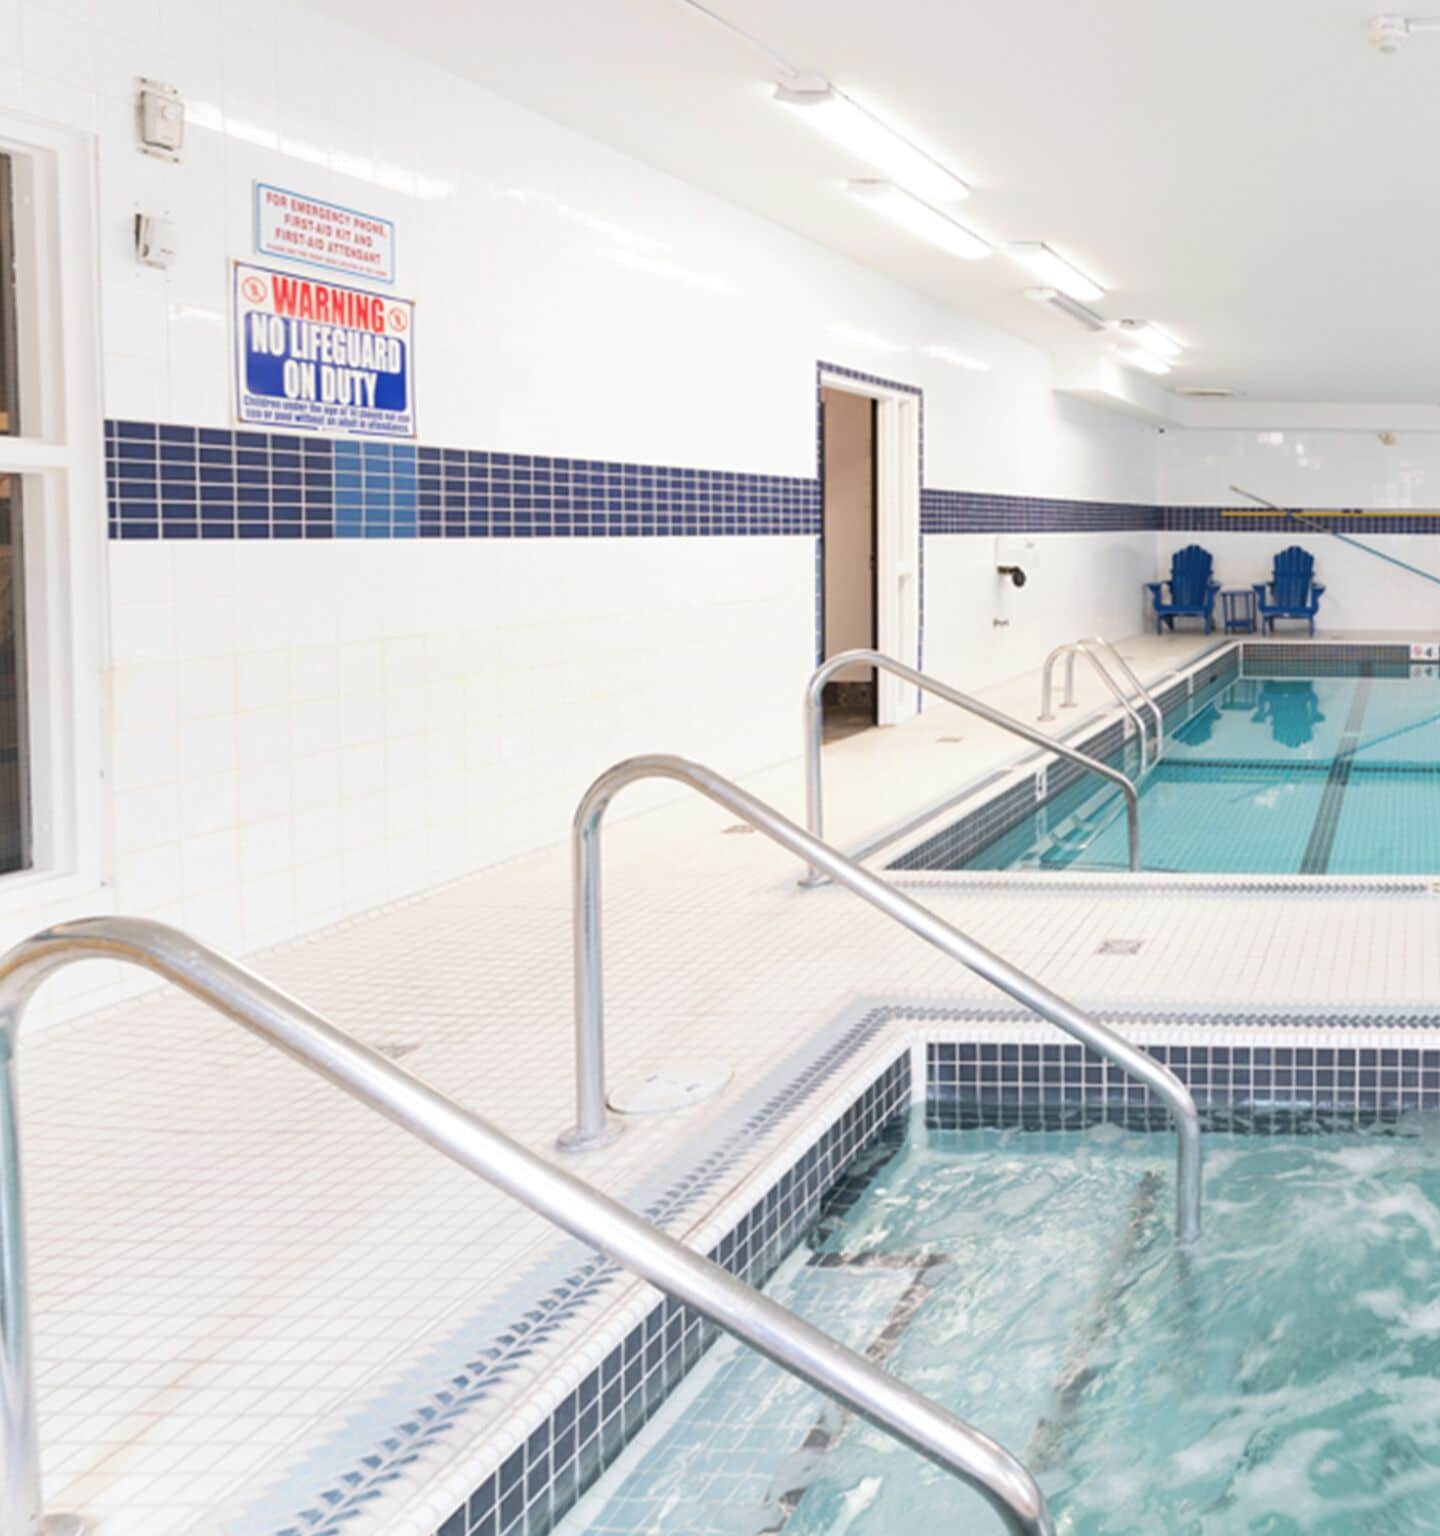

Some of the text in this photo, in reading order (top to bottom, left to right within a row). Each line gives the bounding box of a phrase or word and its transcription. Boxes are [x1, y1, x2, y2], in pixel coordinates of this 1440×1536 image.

[266, 191, 287, 206] FOR
[291, 199, 350, 225] EMERGENCY
[275, 227, 324, 250] FIRST-AID
[328, 242, 380, 264] ATTENDANT
[336, 228, 351, 240] KIT
[354, 234, 372, 248] AND
[272, 275, 384, 333] WARNING
[251, 313, 401, 375] NO LIFEGUARD
[283, 359, 377, 408] ON DUTY
[244, 395, 280, 409] Children
[283, 401, 307, 411] under
[310, 403, 322, 413] the
[324, 406, 338, 417] age
[275, 411, 292, 422] pool
[296, 413, 324, 425] without
[327, 415, 336, 425] an
[339, 417, 357, 427] adult
